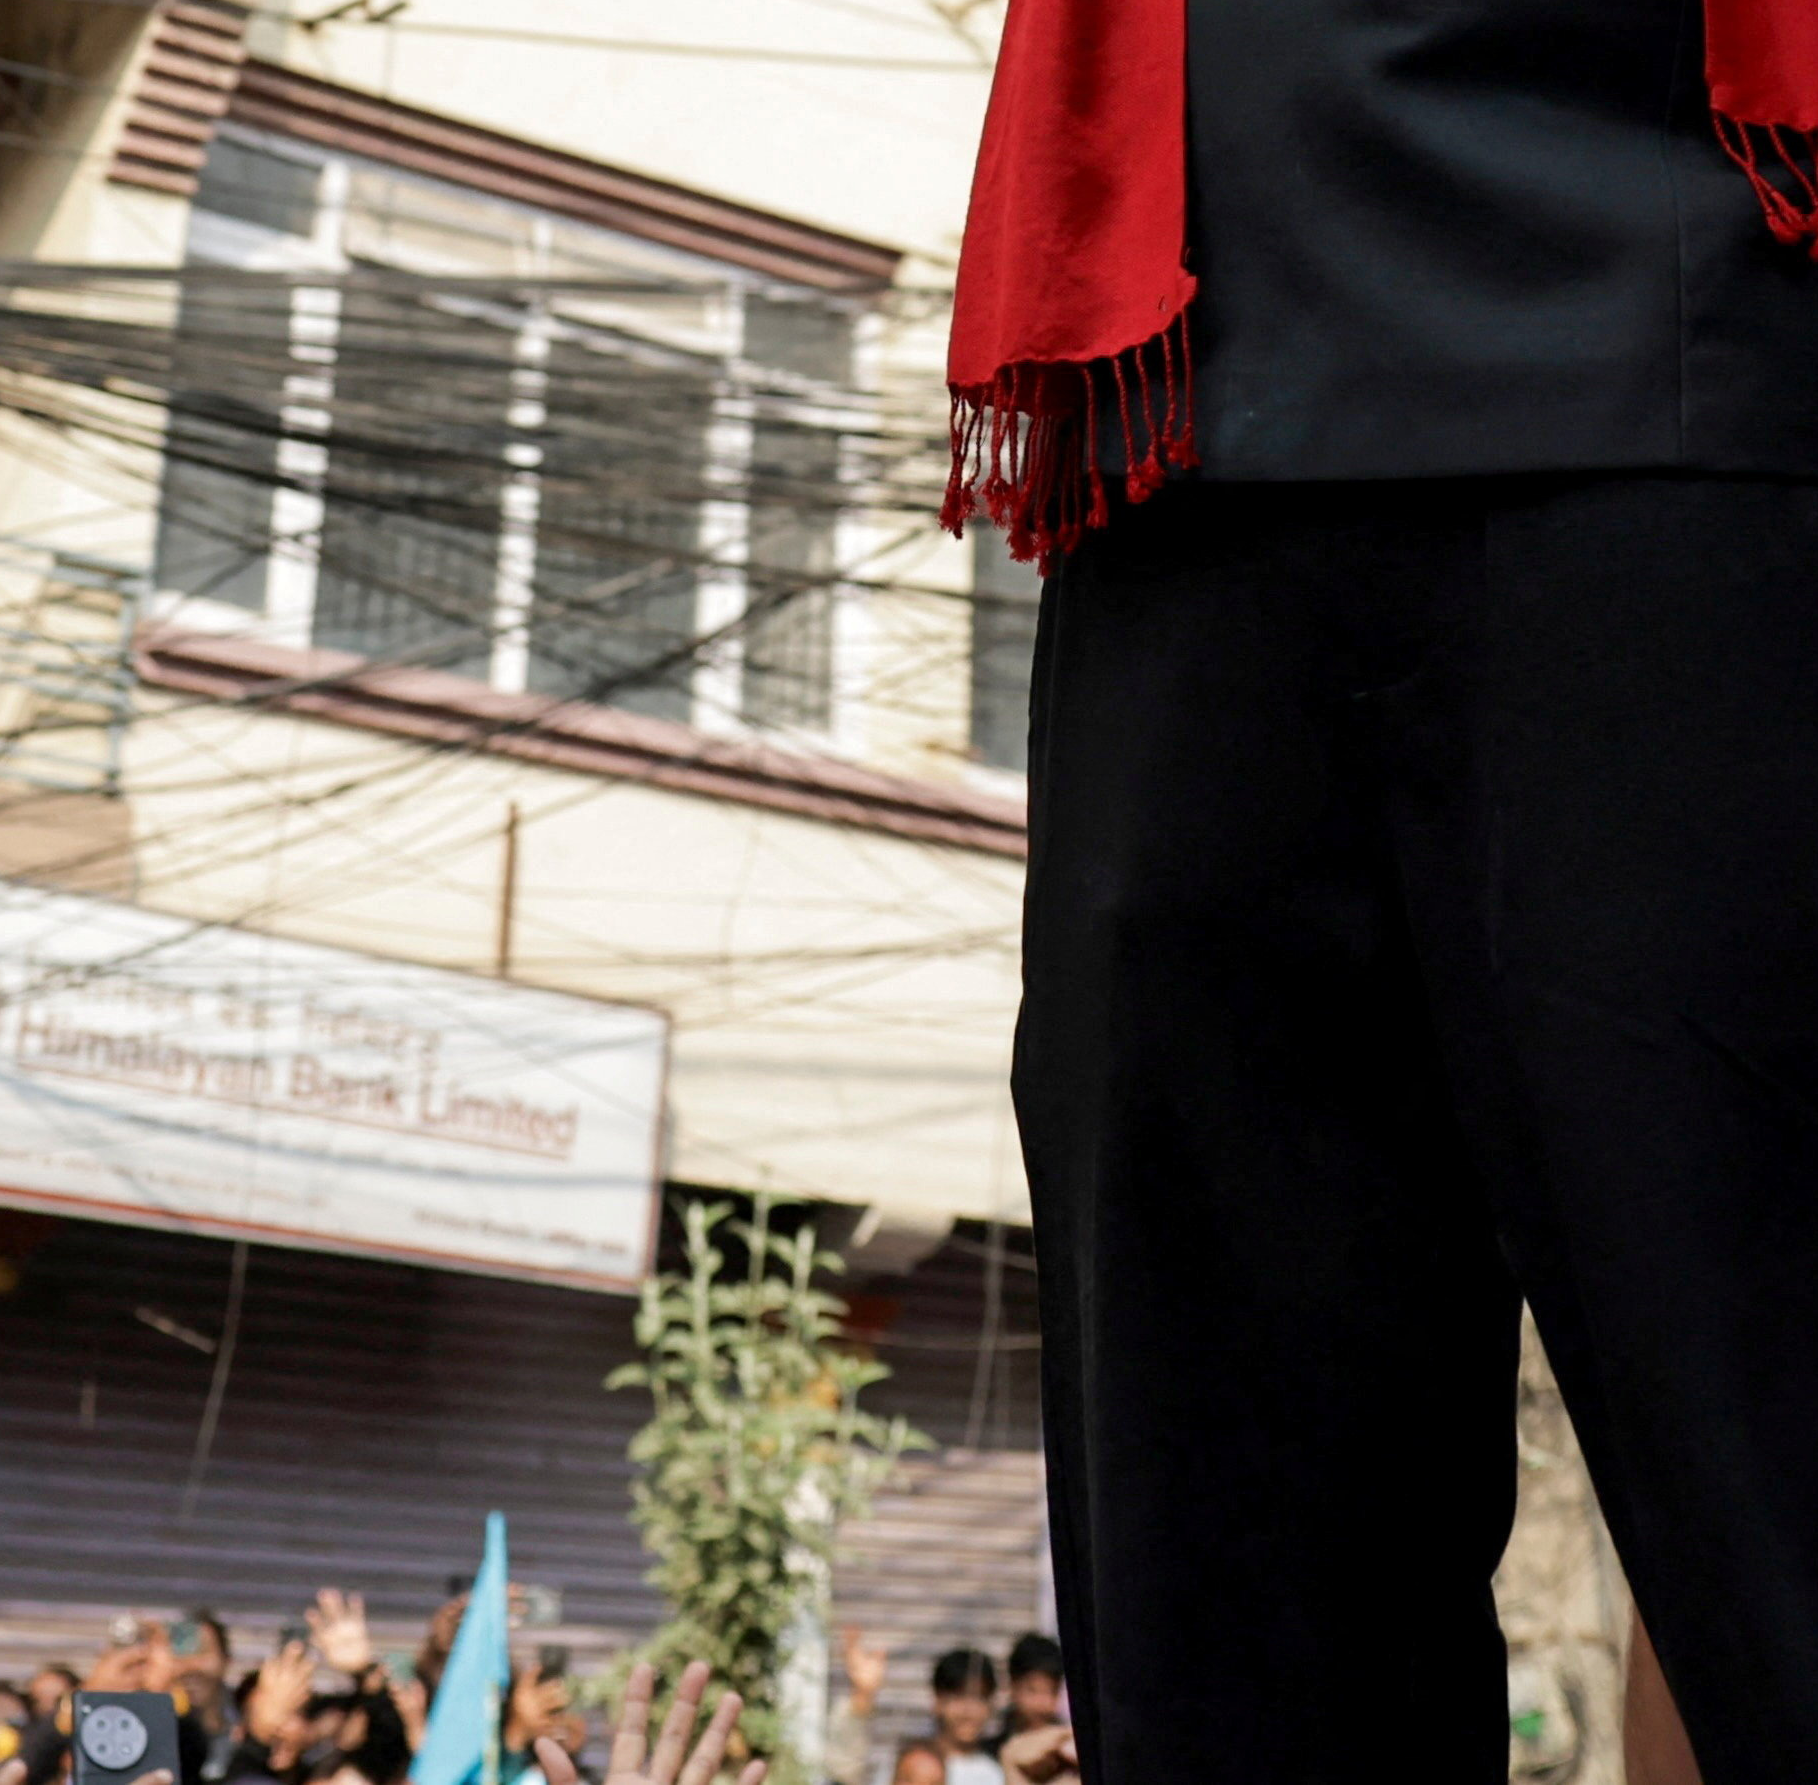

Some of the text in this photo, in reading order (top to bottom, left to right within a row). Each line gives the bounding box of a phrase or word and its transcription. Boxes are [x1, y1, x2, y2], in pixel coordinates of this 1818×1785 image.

[17, 1004, 272, 1098] Himalayan
[290, 1054, 404, 1116] Bank
[418, 1062, 579, 1150] Limited
